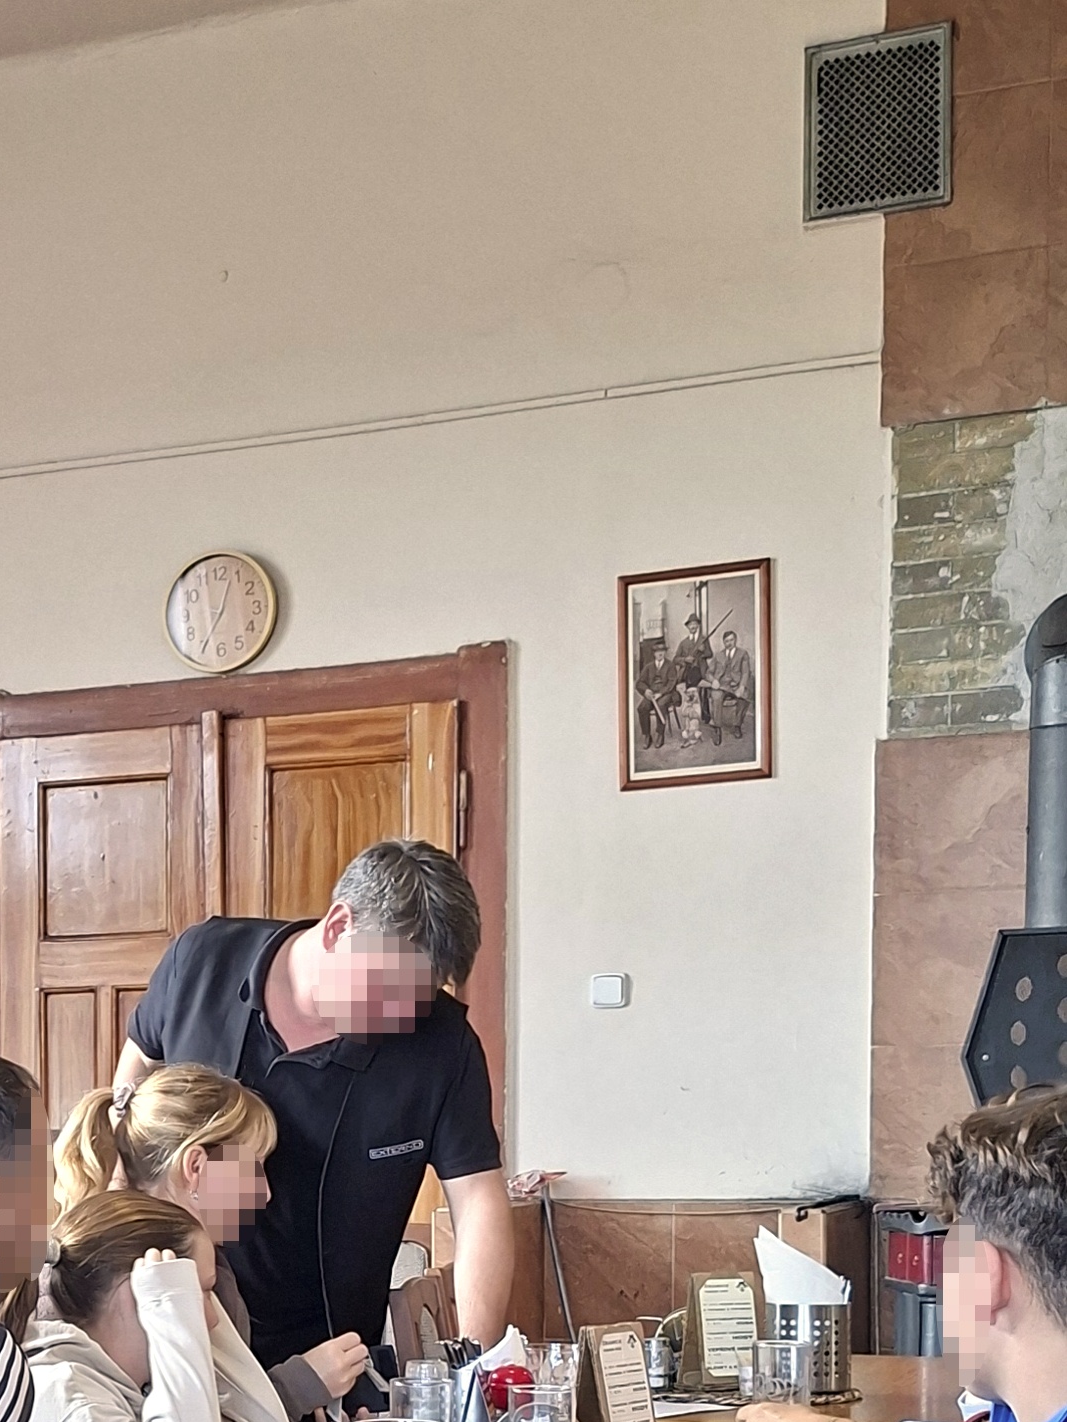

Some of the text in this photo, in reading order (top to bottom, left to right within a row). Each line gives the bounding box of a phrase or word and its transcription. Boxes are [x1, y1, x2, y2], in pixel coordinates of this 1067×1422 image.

[213, 566, 227, 581] 12
[235, 569, 241, 583] 1
[245, 580, 255, 596] 2
[185, 589, 199, 604] 10
[252, 600, 262, 615] 3
[182, 609, 190, 623] 9
[187, 626, 196, 642] 8
[245, 620, 256, 634] 4
[216, 642, 227, 657] 6
[234, 635, 244, 651] 5
